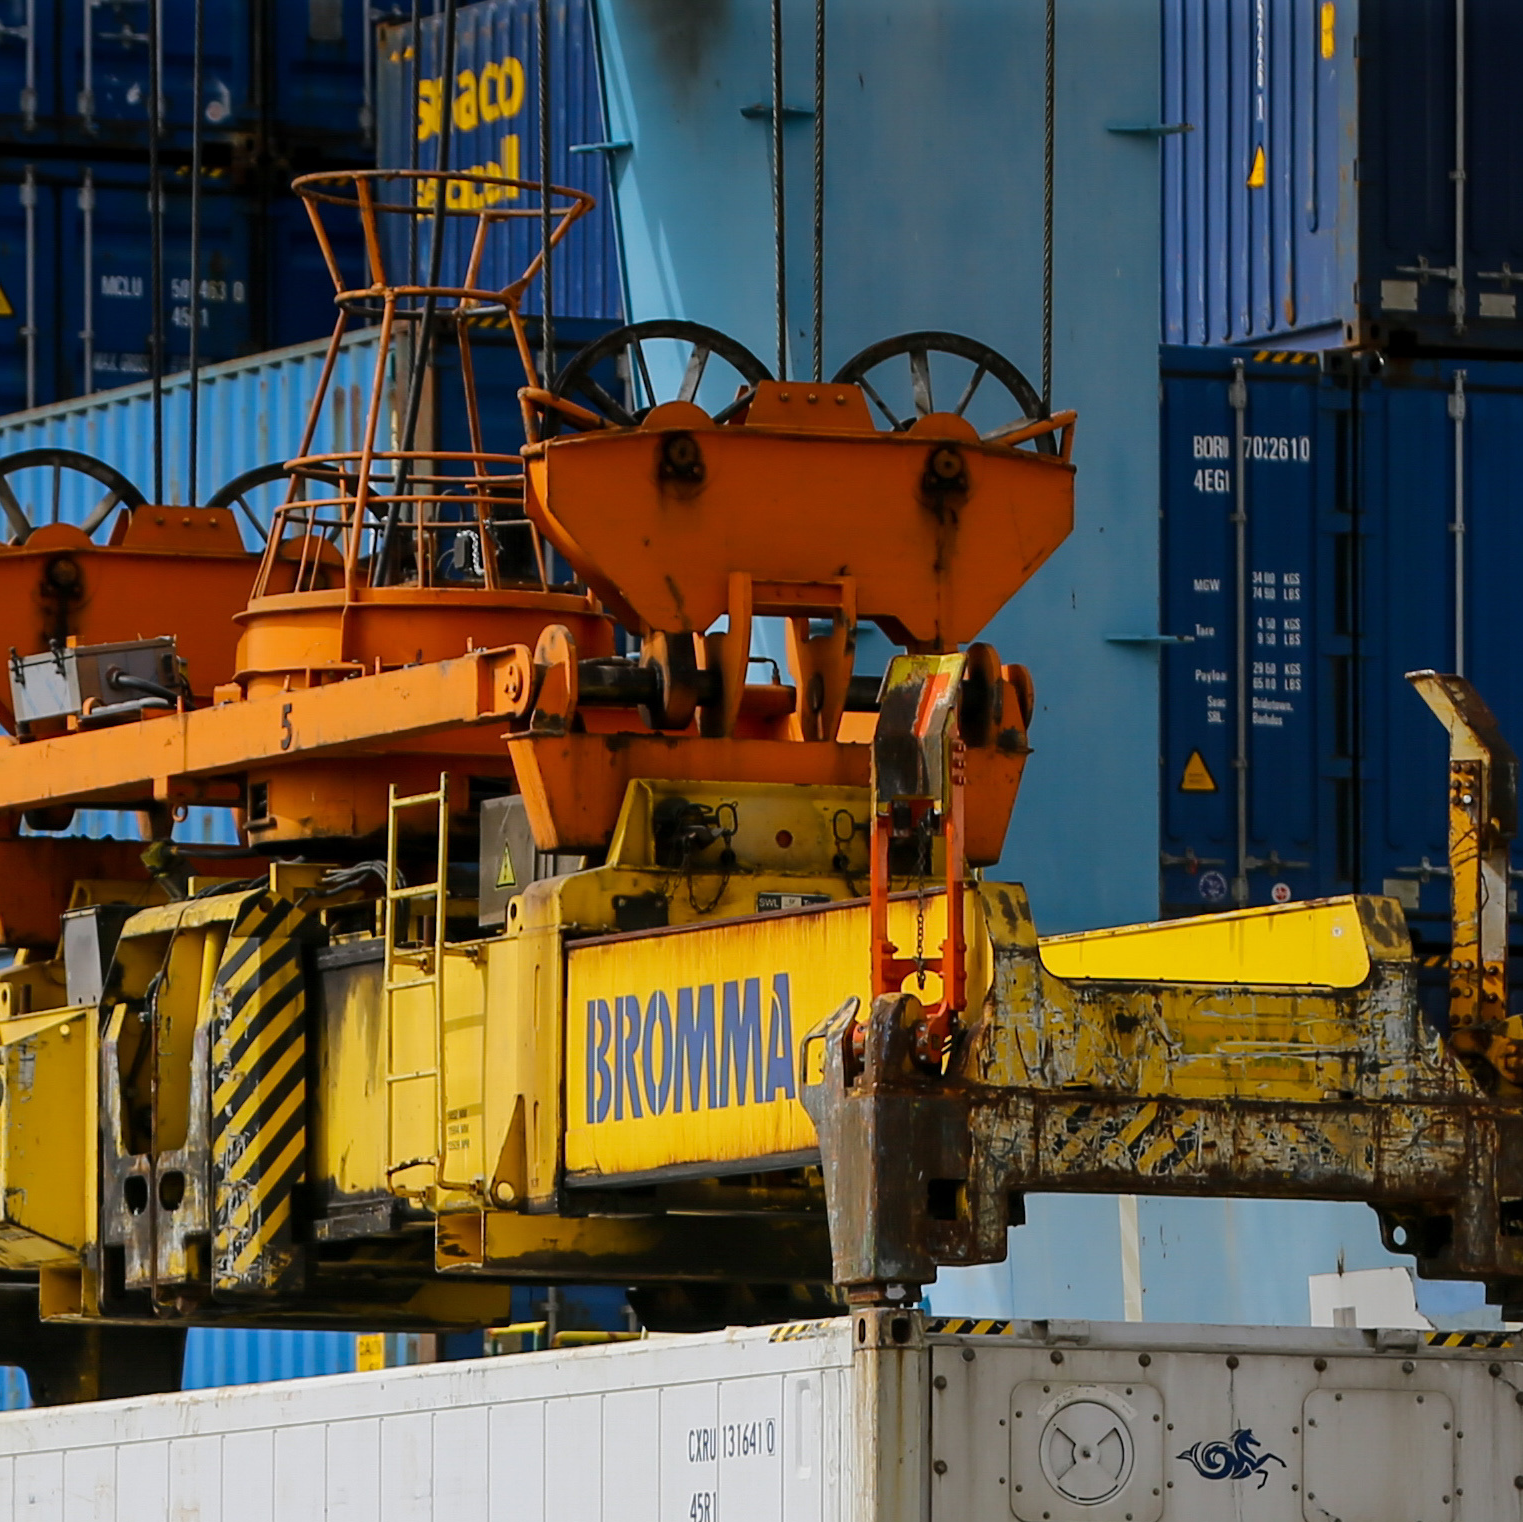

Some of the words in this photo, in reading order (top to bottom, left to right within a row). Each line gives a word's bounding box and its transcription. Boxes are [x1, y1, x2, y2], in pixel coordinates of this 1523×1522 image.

[1194, 579, 1220, 591] MGW
[1283, 573, 1300, 585] KGS
[1284, 588, 1300, 600] LBS
[1284, 618, 1300, 630] KGS
[1284, 634, 1300, 646] LBS
[1285, 663, 1301, 675] KGS
[1285, 678, 1301, 691] LBS
[280, 704, 294, 750] 5
[759, 898, 779, 908] SWL
[586, 973, 796, 1124] BROMMA
[688, 1428, 716, 1462] CXRU
